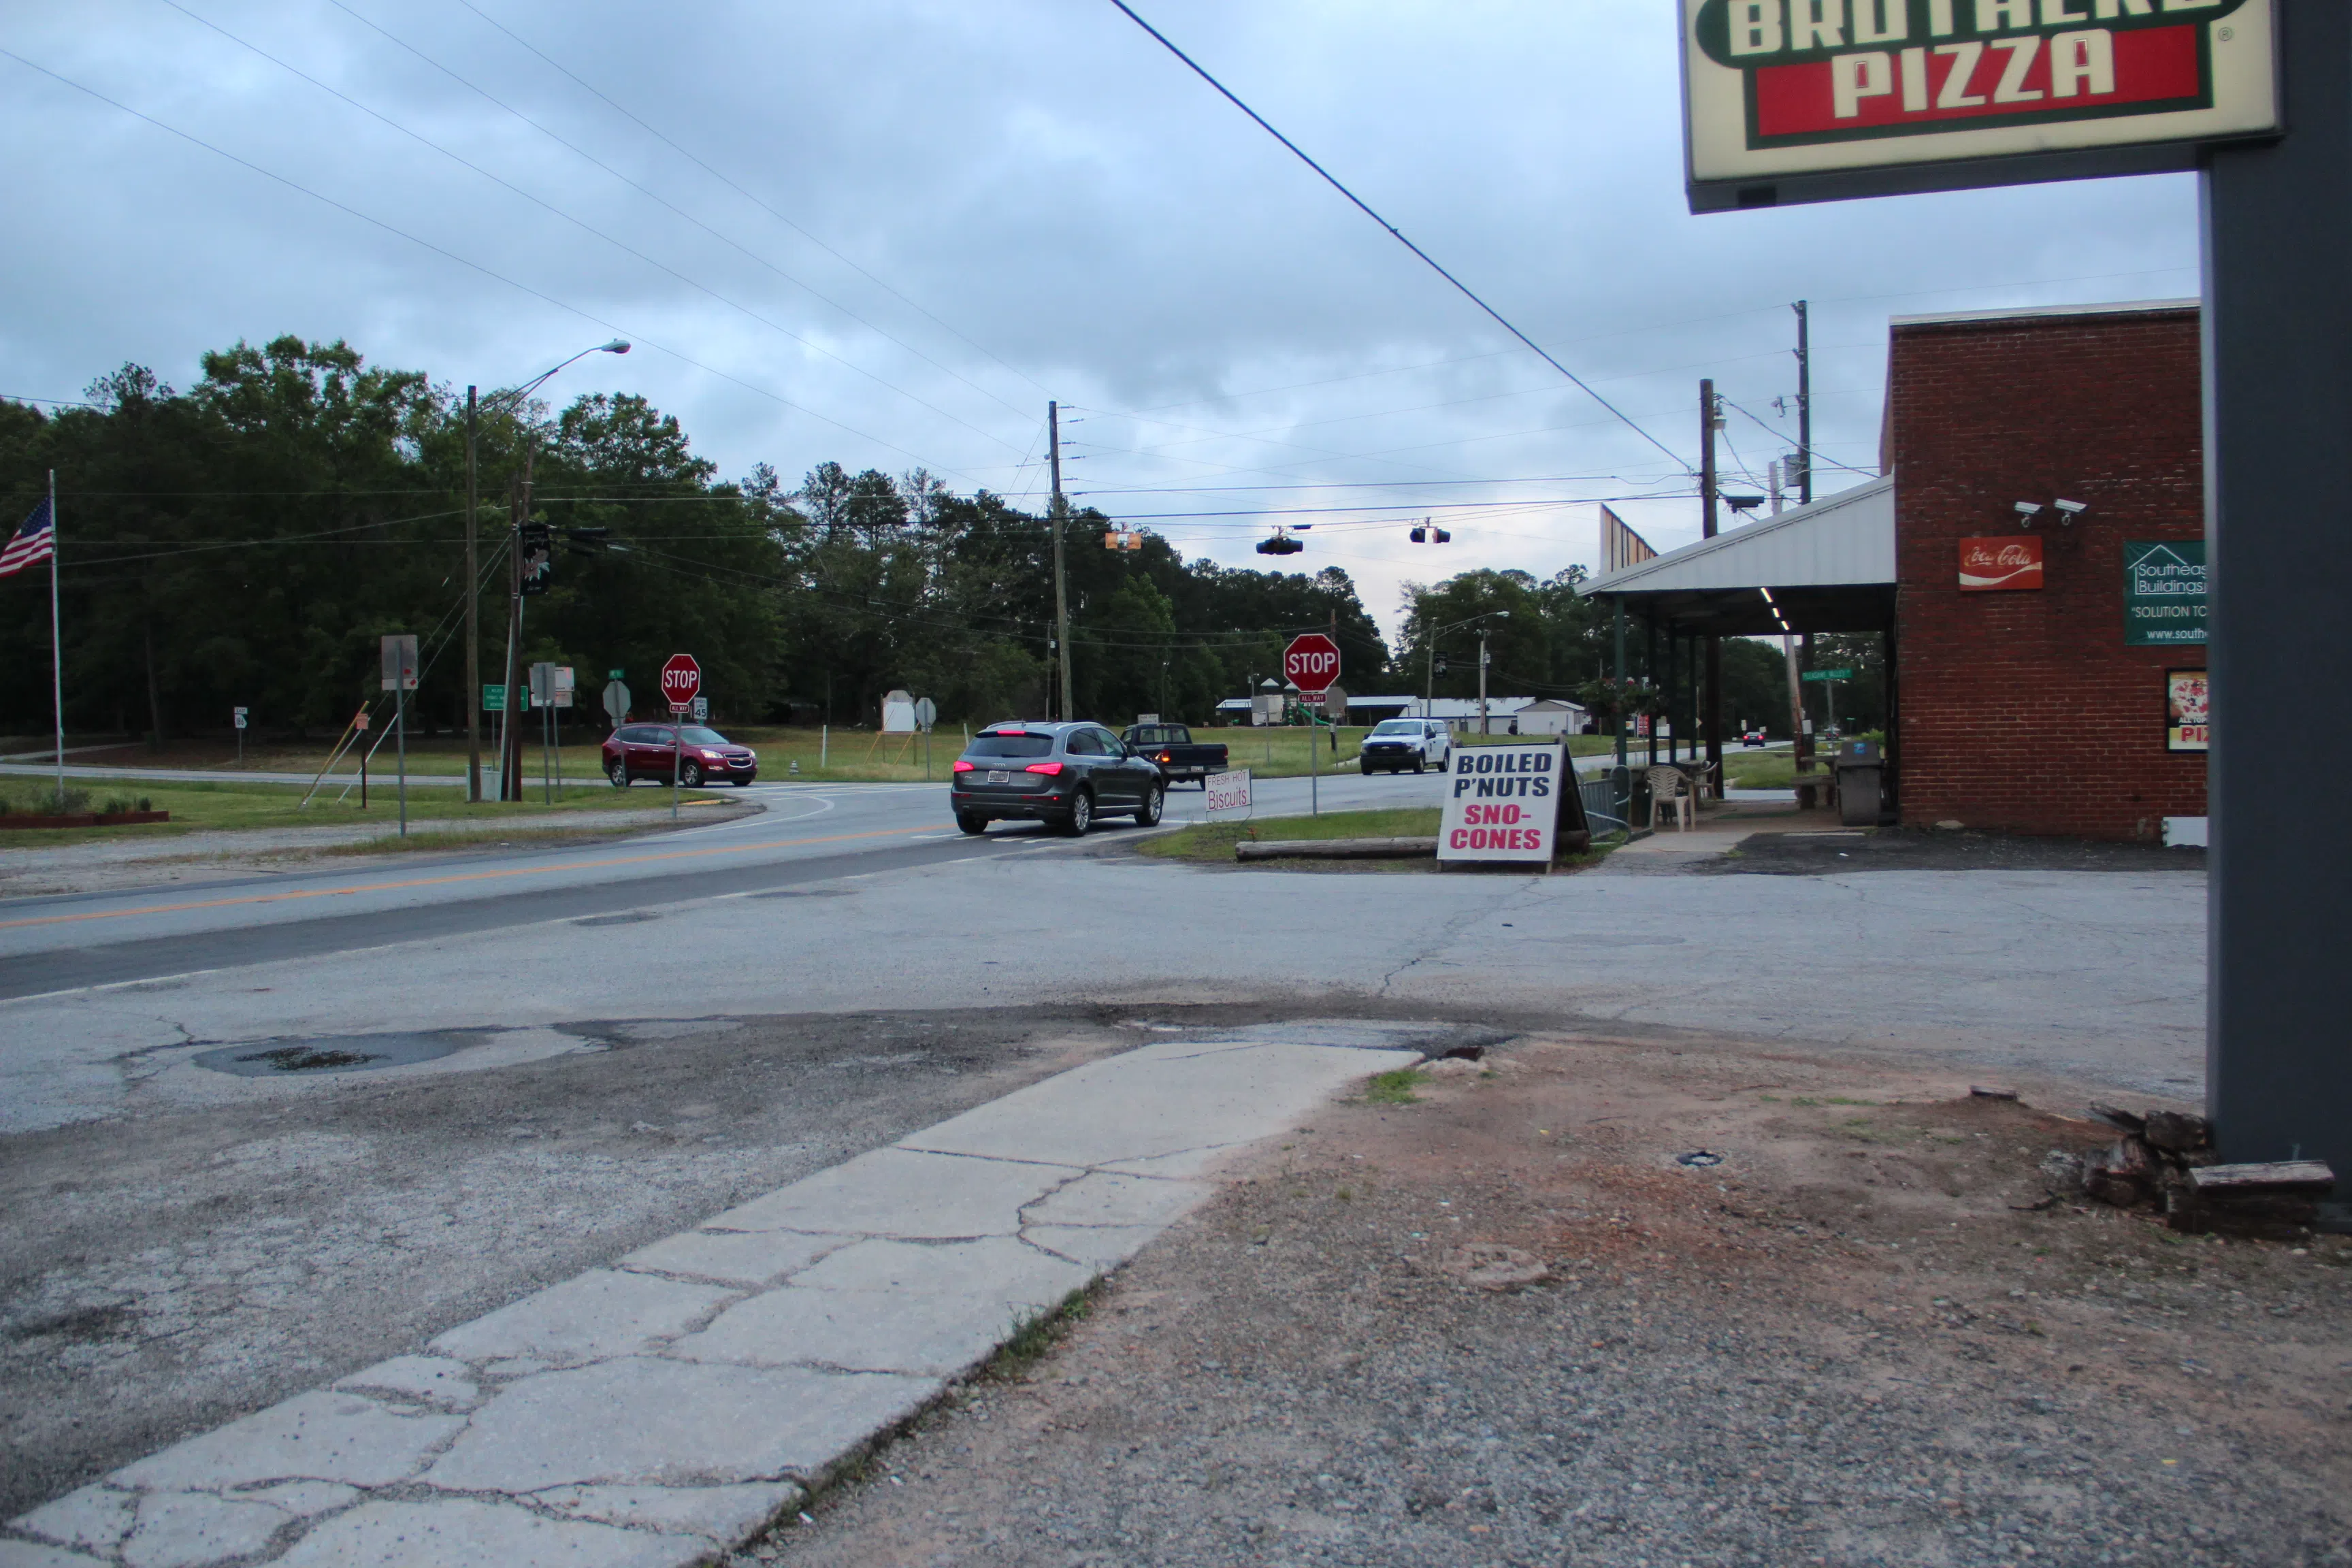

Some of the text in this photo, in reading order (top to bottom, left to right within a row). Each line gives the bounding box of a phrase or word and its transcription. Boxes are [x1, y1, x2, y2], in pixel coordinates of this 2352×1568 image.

[1832, 29, 2115, 118] PIZZA
[2138, 564, 2207, 576] Southeas
[2139, 580, 2203, 595] Buildings
[2146, 628, 2208, 639] www.south
[1288, 652, 1336, 674] STOP
[665, 670, 698, 689] STOP
[695, 709, 706, 717] 45
[1456, 753, 1552, 774] BOILED
[1207, 771, 1246, 786] FRESH HOT
[1453, 777, 1550, 798] P'NUTS
[1208, 786, 1247, 810] Biscuits
[1464, 804, 1531, 825] SNO-
[1450, 828, 1541, 850] CONES
